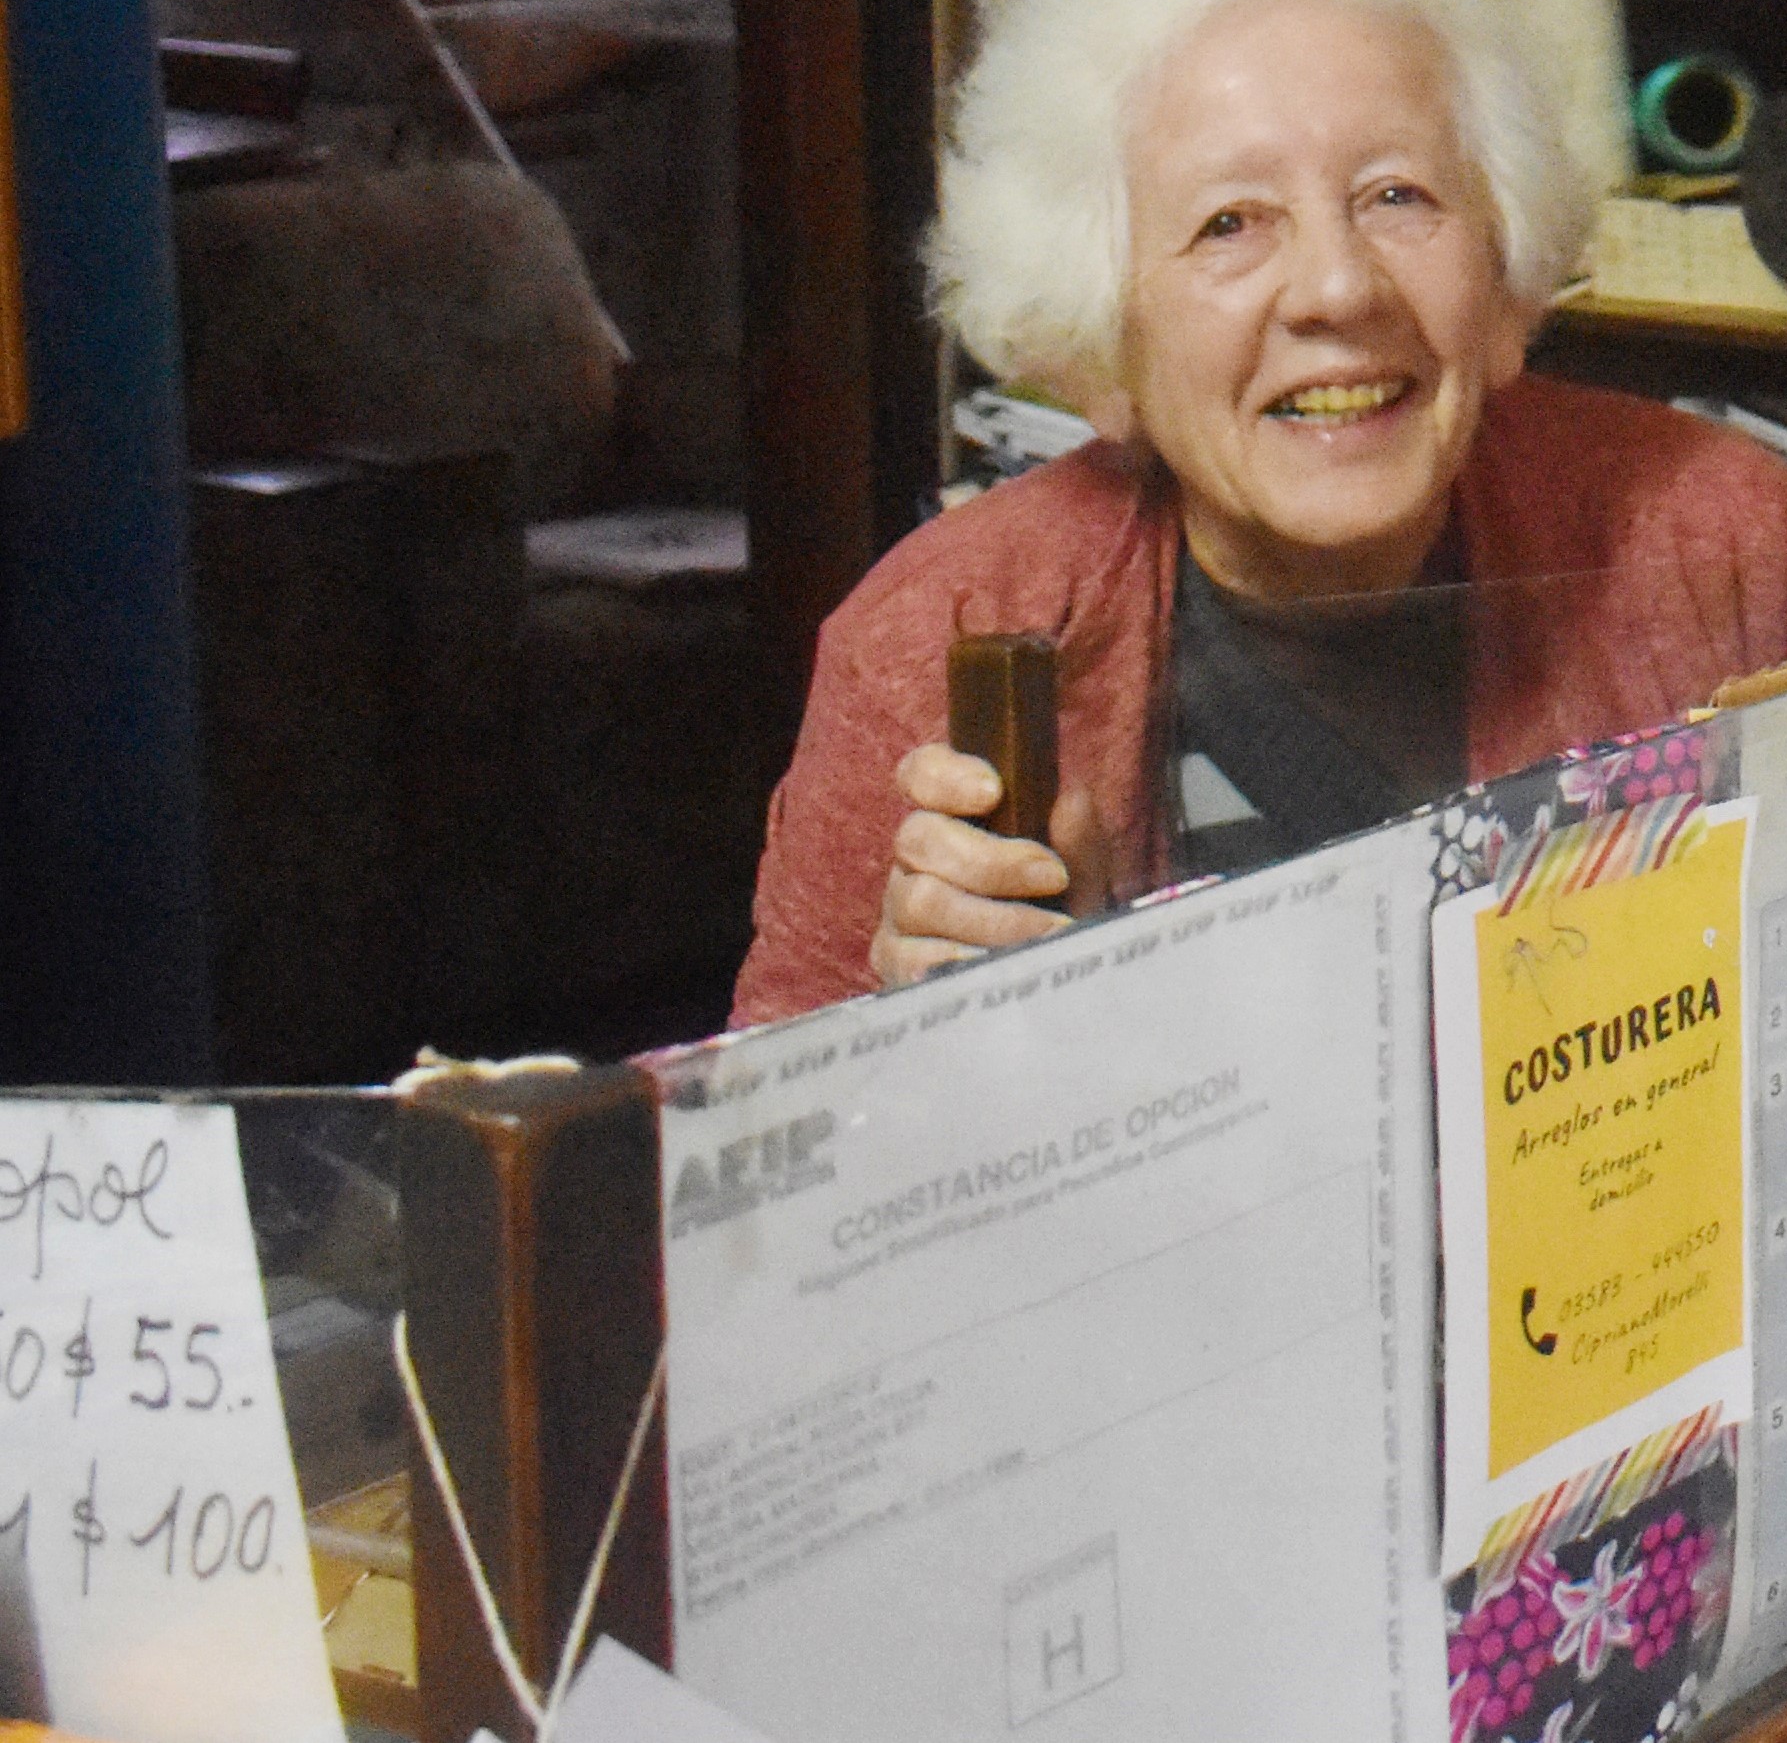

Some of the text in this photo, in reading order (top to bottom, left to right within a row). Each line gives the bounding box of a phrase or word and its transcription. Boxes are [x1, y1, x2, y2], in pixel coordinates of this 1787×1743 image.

[1503, 976, 1722, 1106] COSTURERA
[1512, 1042, 1721, 1166] Arreglos en general
[1770, 1072, 1783, 1097] 3
[670, 1108, 838, 1213] AFIP
[832, 1140, 1062, 1251] CONSTANCIA
[1071, 1116, 1114, 1160] DE
[1124, 1066, 1241, 1139] OPCION
[1578, 1138, 1664, 1187] Entregas a
[1588, 1170, 1656, 1212] domicilio
[1773, 1218, 1787, 1239] 4
[1770, 1406, 1784, 1430] 5
[1766, 1580, 1779, 1603] 6
[1040, 1613, 1086, 1692] H
